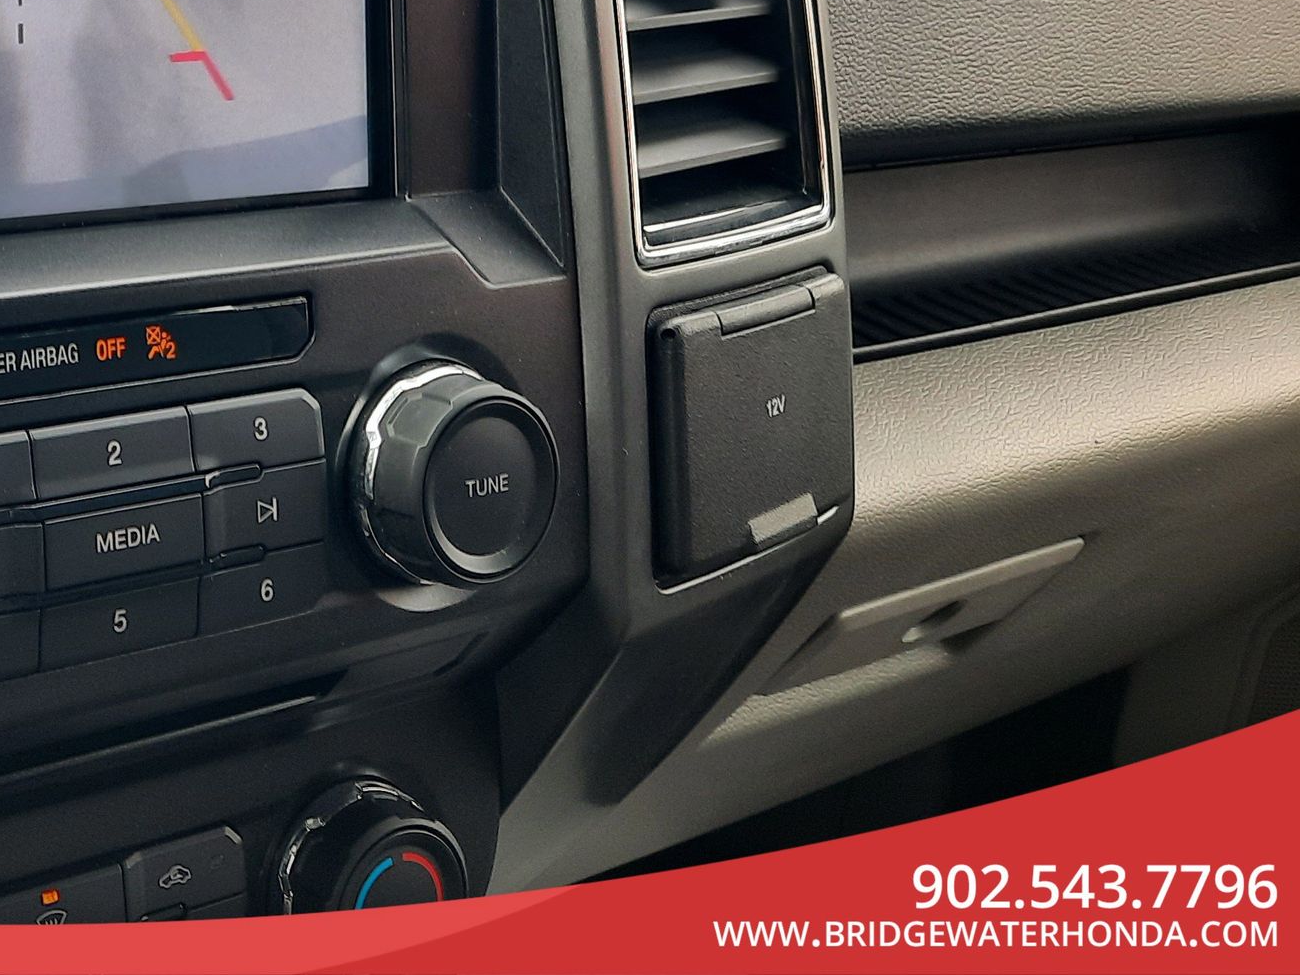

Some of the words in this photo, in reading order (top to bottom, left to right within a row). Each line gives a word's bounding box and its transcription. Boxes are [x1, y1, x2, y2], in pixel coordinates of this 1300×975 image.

[19, 342, 79, 370] AIRBAG
[96, 337, 127, 361] OFF
[766, 394, 786, 418] 12V
[254, 417, 268, 441] 3
[107, 440, 122, 466] 2
[465, 473, 509, 498] TUNE
[95, 524, 160, 553] MEDIA
[261, 579, 274, 602] 6
[113, 609, 128, 633] 5
